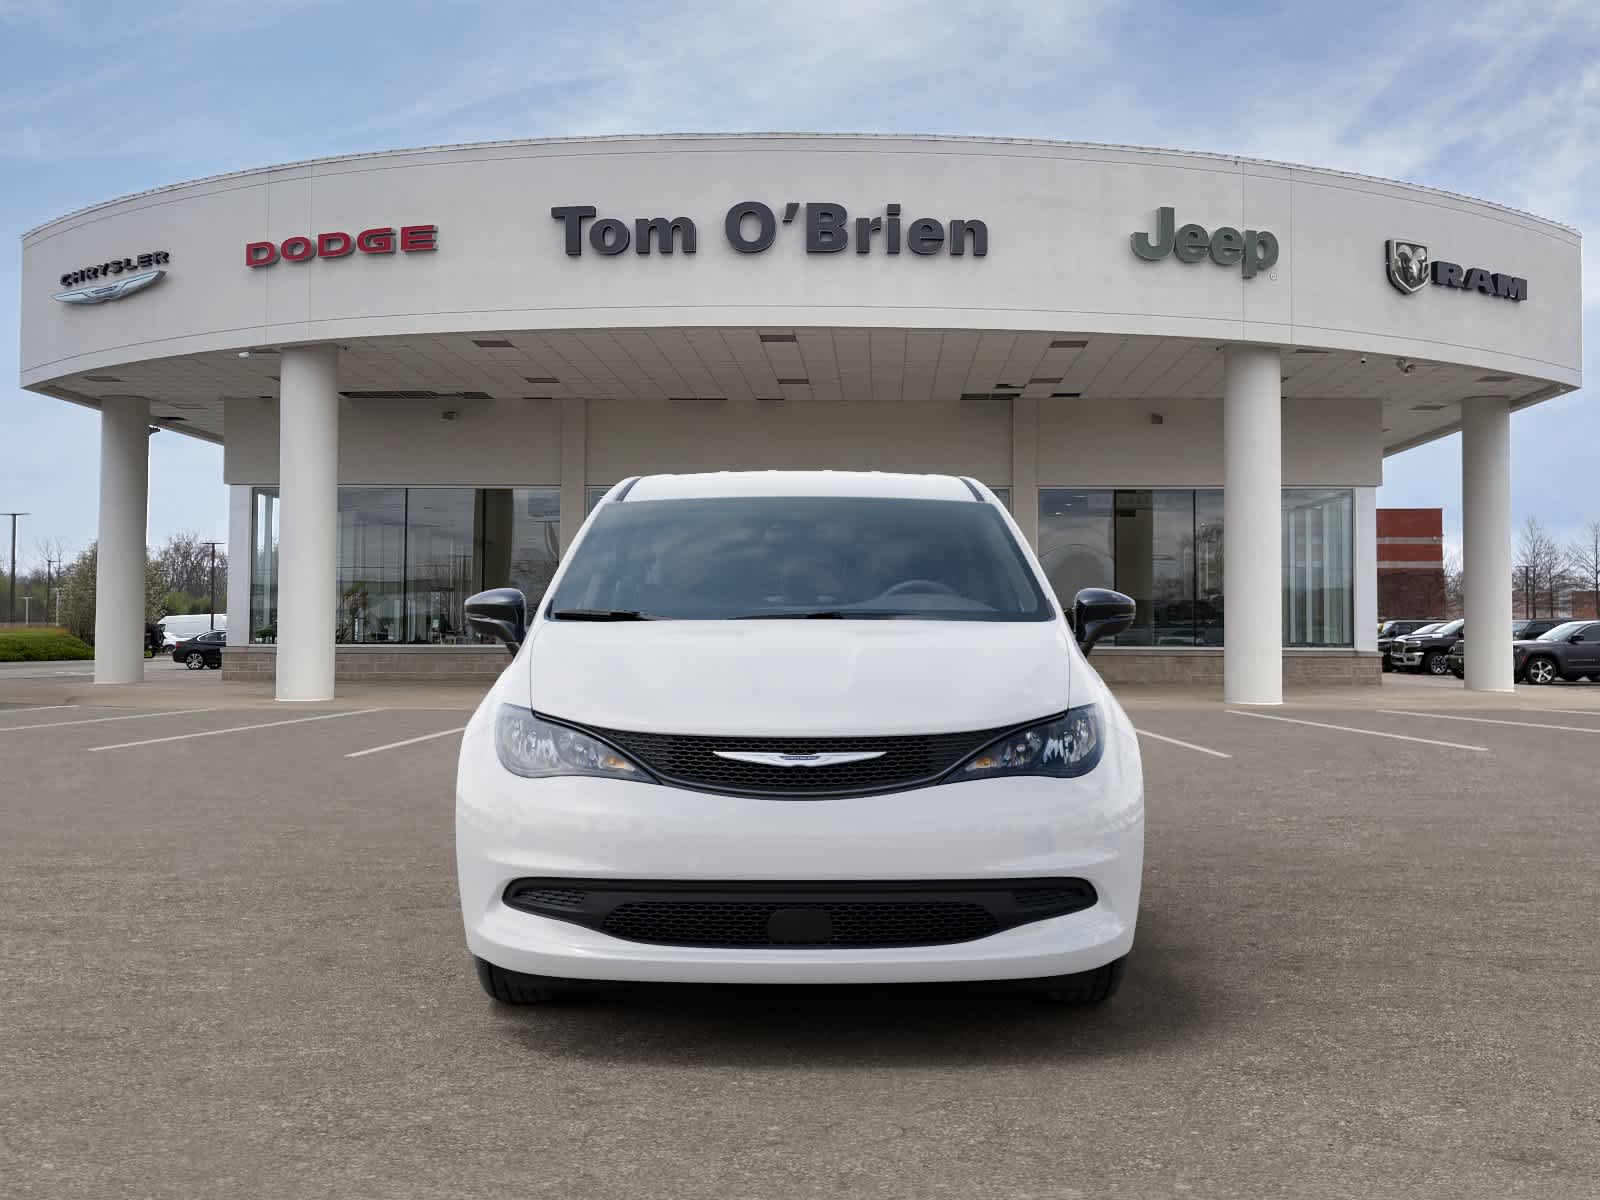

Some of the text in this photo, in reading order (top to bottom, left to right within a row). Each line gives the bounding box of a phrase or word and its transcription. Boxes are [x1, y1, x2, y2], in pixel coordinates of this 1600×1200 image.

[245, 224, 438, 268] DODGE
[551, 201, 989, 257] Tom O'Brien
[1131, 206, 1280, 279] Jeep
[60, 249, 170, 287] CHRYSLER
[1431, 261, 1528, 301] RAM
